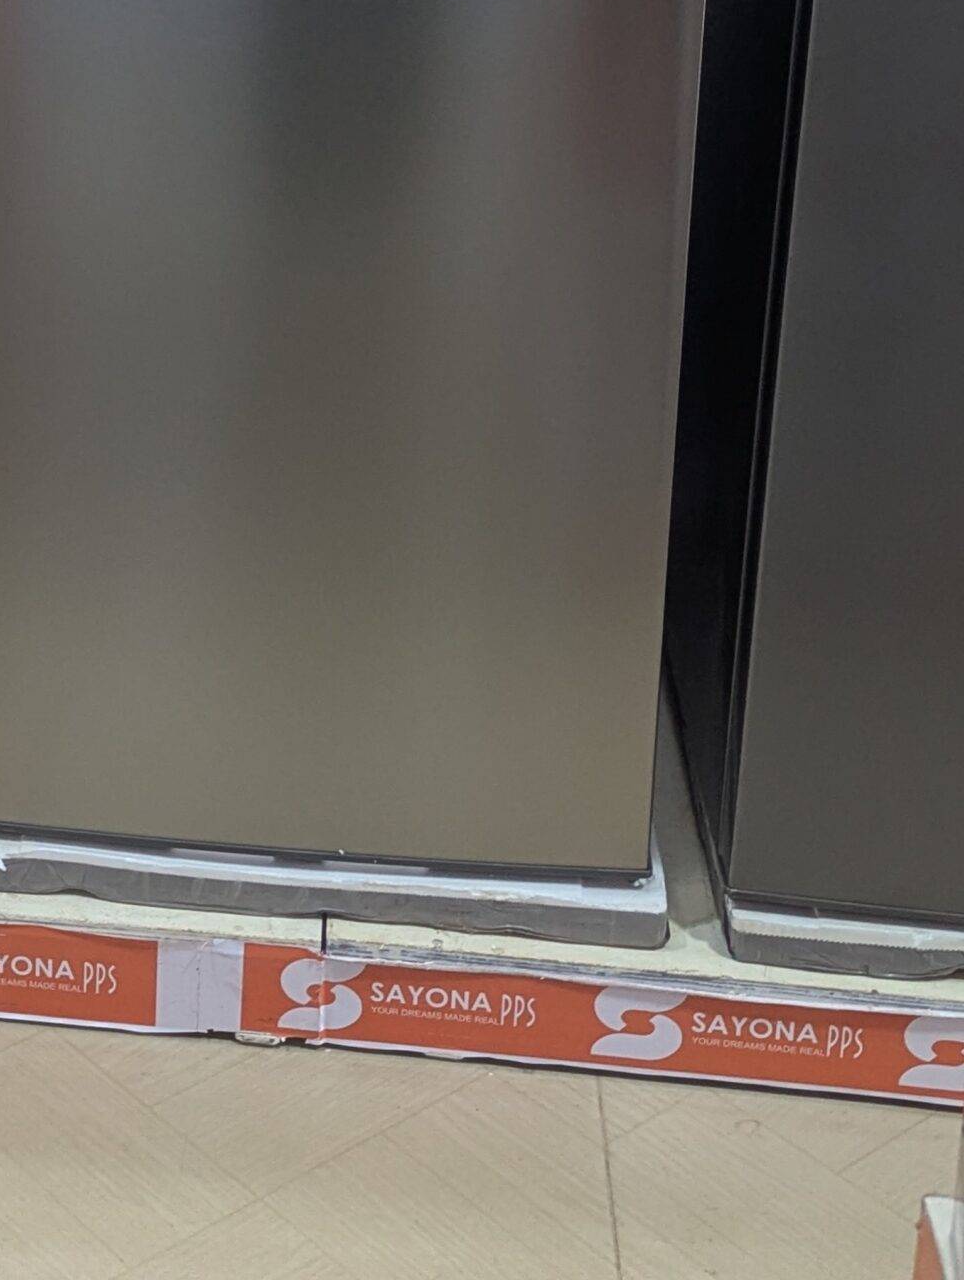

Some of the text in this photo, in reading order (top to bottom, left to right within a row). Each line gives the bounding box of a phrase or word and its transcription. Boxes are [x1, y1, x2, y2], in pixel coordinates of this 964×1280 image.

[29, 980, 56, 991] MADE
[58, 983, 84, 993] REAL
[370, 982, 492, 1013] SAYONA
[371, 1006, 500, 1026] YOUR DREAMS MADE REAL
[691, 1012, 819, 1044] SAYONA
[691, 1036, 826, 1057] YOUR DREAMS MADE REAL
